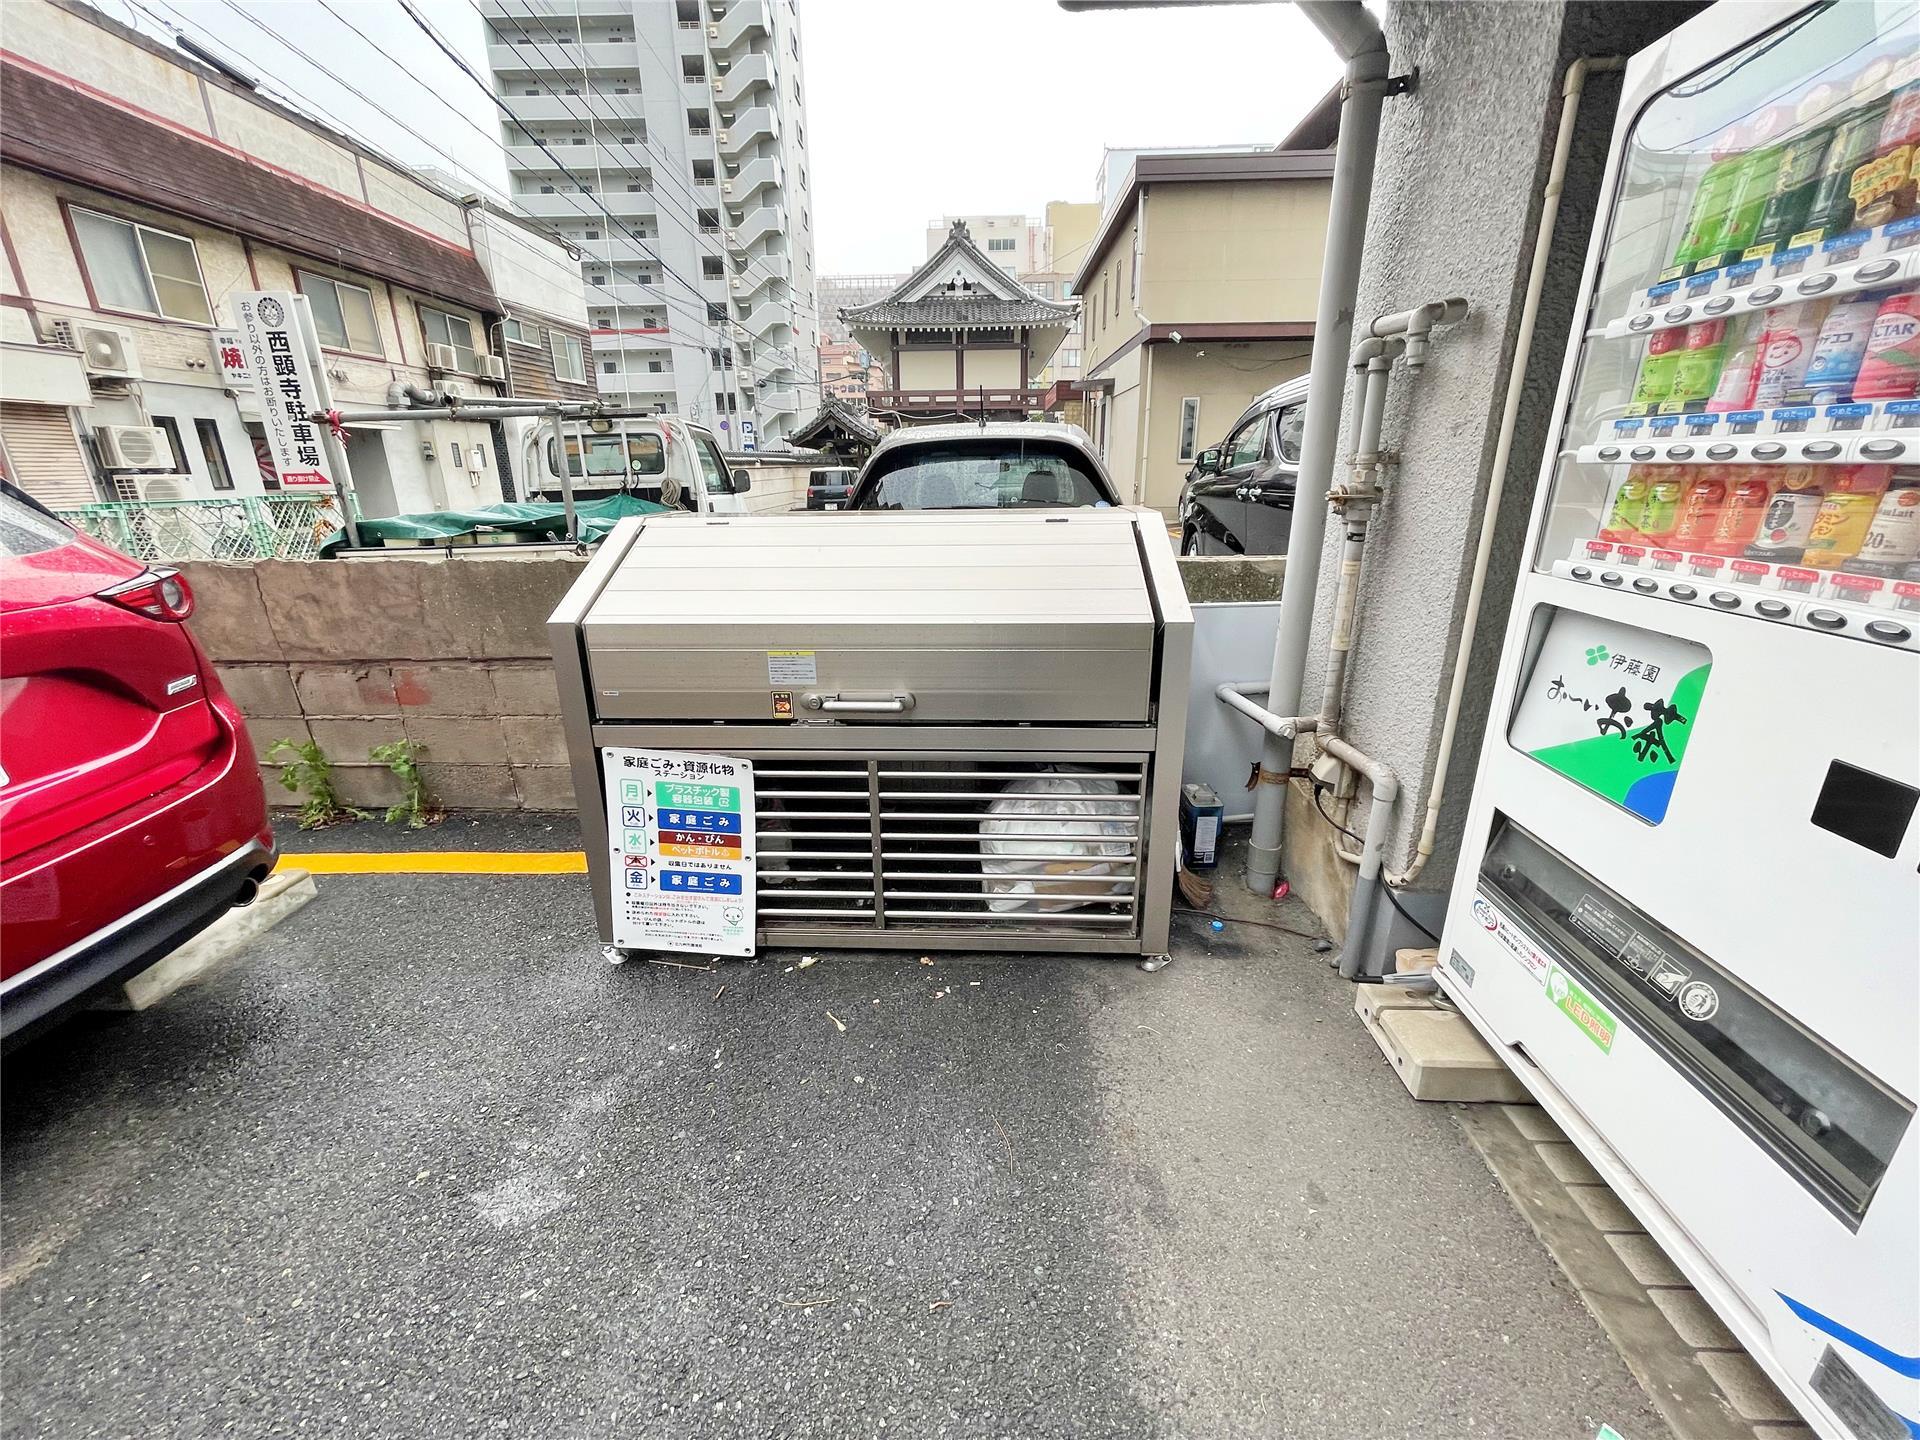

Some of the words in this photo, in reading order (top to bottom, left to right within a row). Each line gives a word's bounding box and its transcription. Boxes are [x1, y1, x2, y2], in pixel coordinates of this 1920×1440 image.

[220, 346, 248, 369] 焼
[240, 301, 292, 467] お参り以外の方はお断りいたします
[265, 331, 320, 467] 西顕寺駐車場
[1609, 653, 1660, 683] 伊藤園
[623, 756, 735, 776] 家庭ごみ・資源化物
[654, 769, 705, 780] ステーション
[625, 784, 639, 798] 月
[664, 783, 730, 798] プラスチック製
[671, 794, 714, 806] 容器包装
[626, 809, 641, 822] 火
[668, 813, 730, 827] 家庭ごみ
[628, 832, 643, 846] 水
[675, 833, 725, 844] かん・びん
[671, 846, 721, 856] ペットボトル
[668, 860, 733, 870] 収集日ではありません
[629, 871, 643, 884] 金
[671, 874, 731, 888] 家庭ごみ
